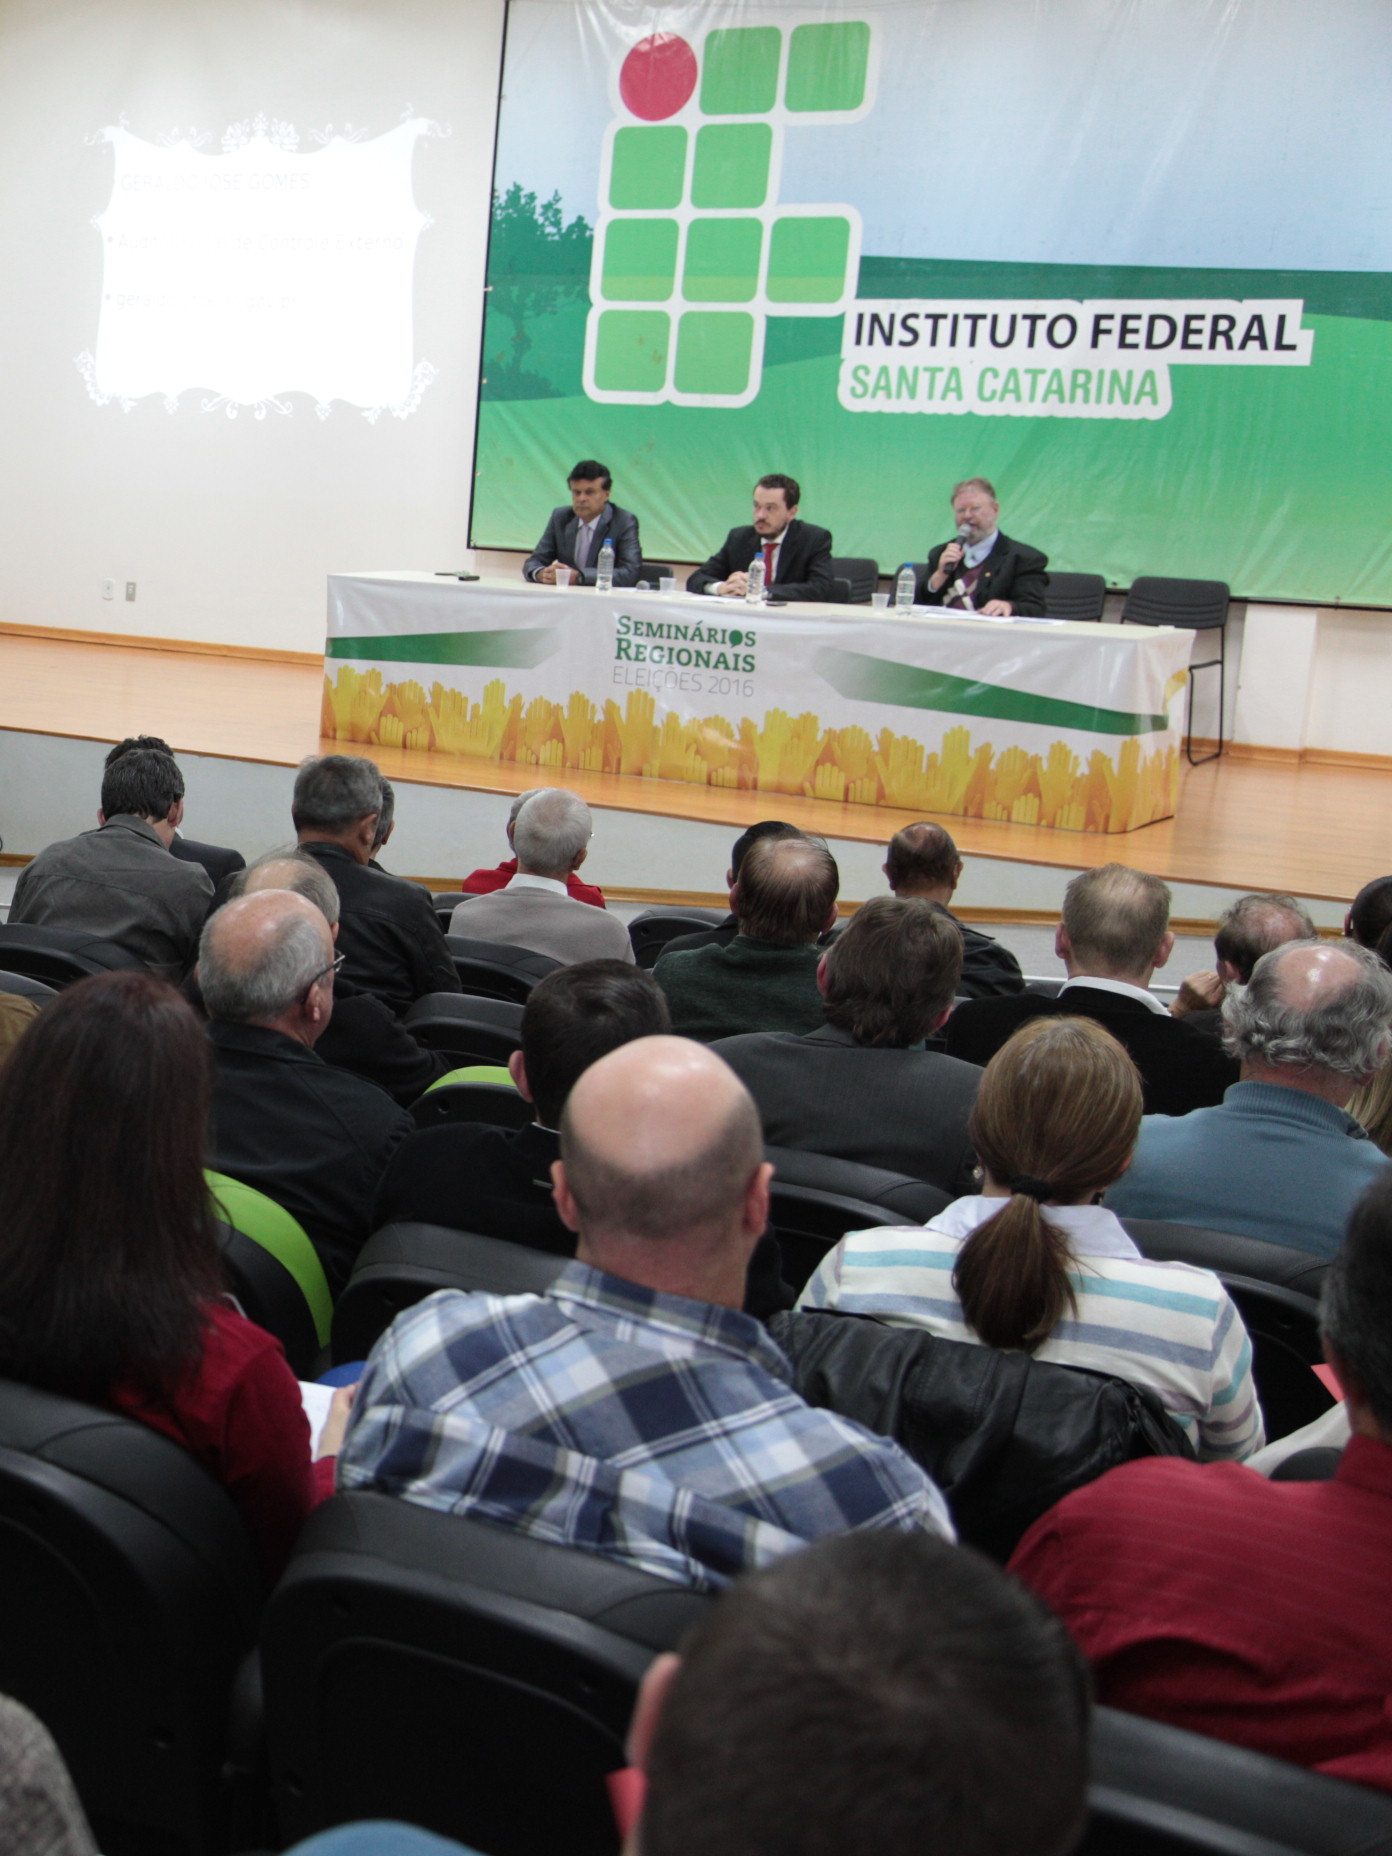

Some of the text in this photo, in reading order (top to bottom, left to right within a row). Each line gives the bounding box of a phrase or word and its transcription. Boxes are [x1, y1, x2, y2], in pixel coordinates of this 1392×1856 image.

[120, 173, 199, 191] GERALDO
[248, 172, 311, 191] GOMES
[335, 233, 404, 250] Externo
[854, 312, 1298, 351] INSTITUTO FEDERAL
[849, 365, 1159, 406] SANTA CATARINA
[616, 615, 757, 648] SEMINÁRIOS
[615, 637, 756, 673] REGIONAIS
[613, 665, 755, 698] ELEIÇÕES 2016
